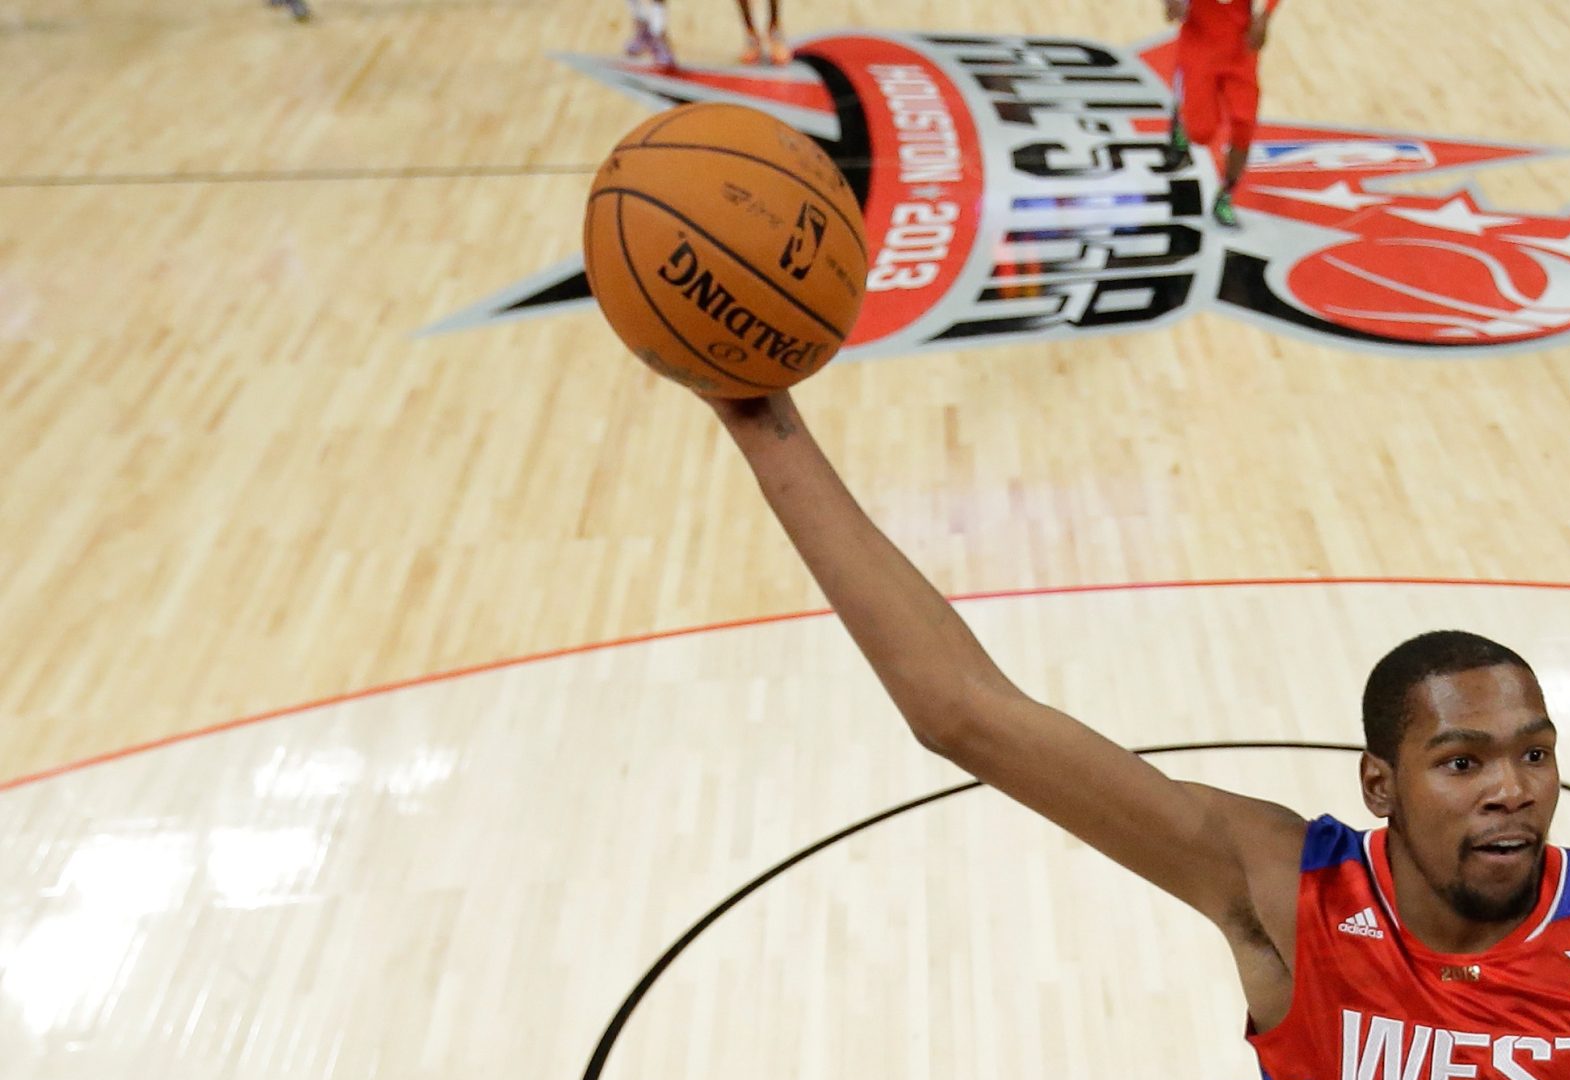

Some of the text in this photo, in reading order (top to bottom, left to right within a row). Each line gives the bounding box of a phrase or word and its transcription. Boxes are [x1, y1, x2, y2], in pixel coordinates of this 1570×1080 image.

[866, 64, 962, 291] HOUSTON 2013
[657, 242, 827, 371] SPALDING
[1338, 922, 1384, 940] adidas
